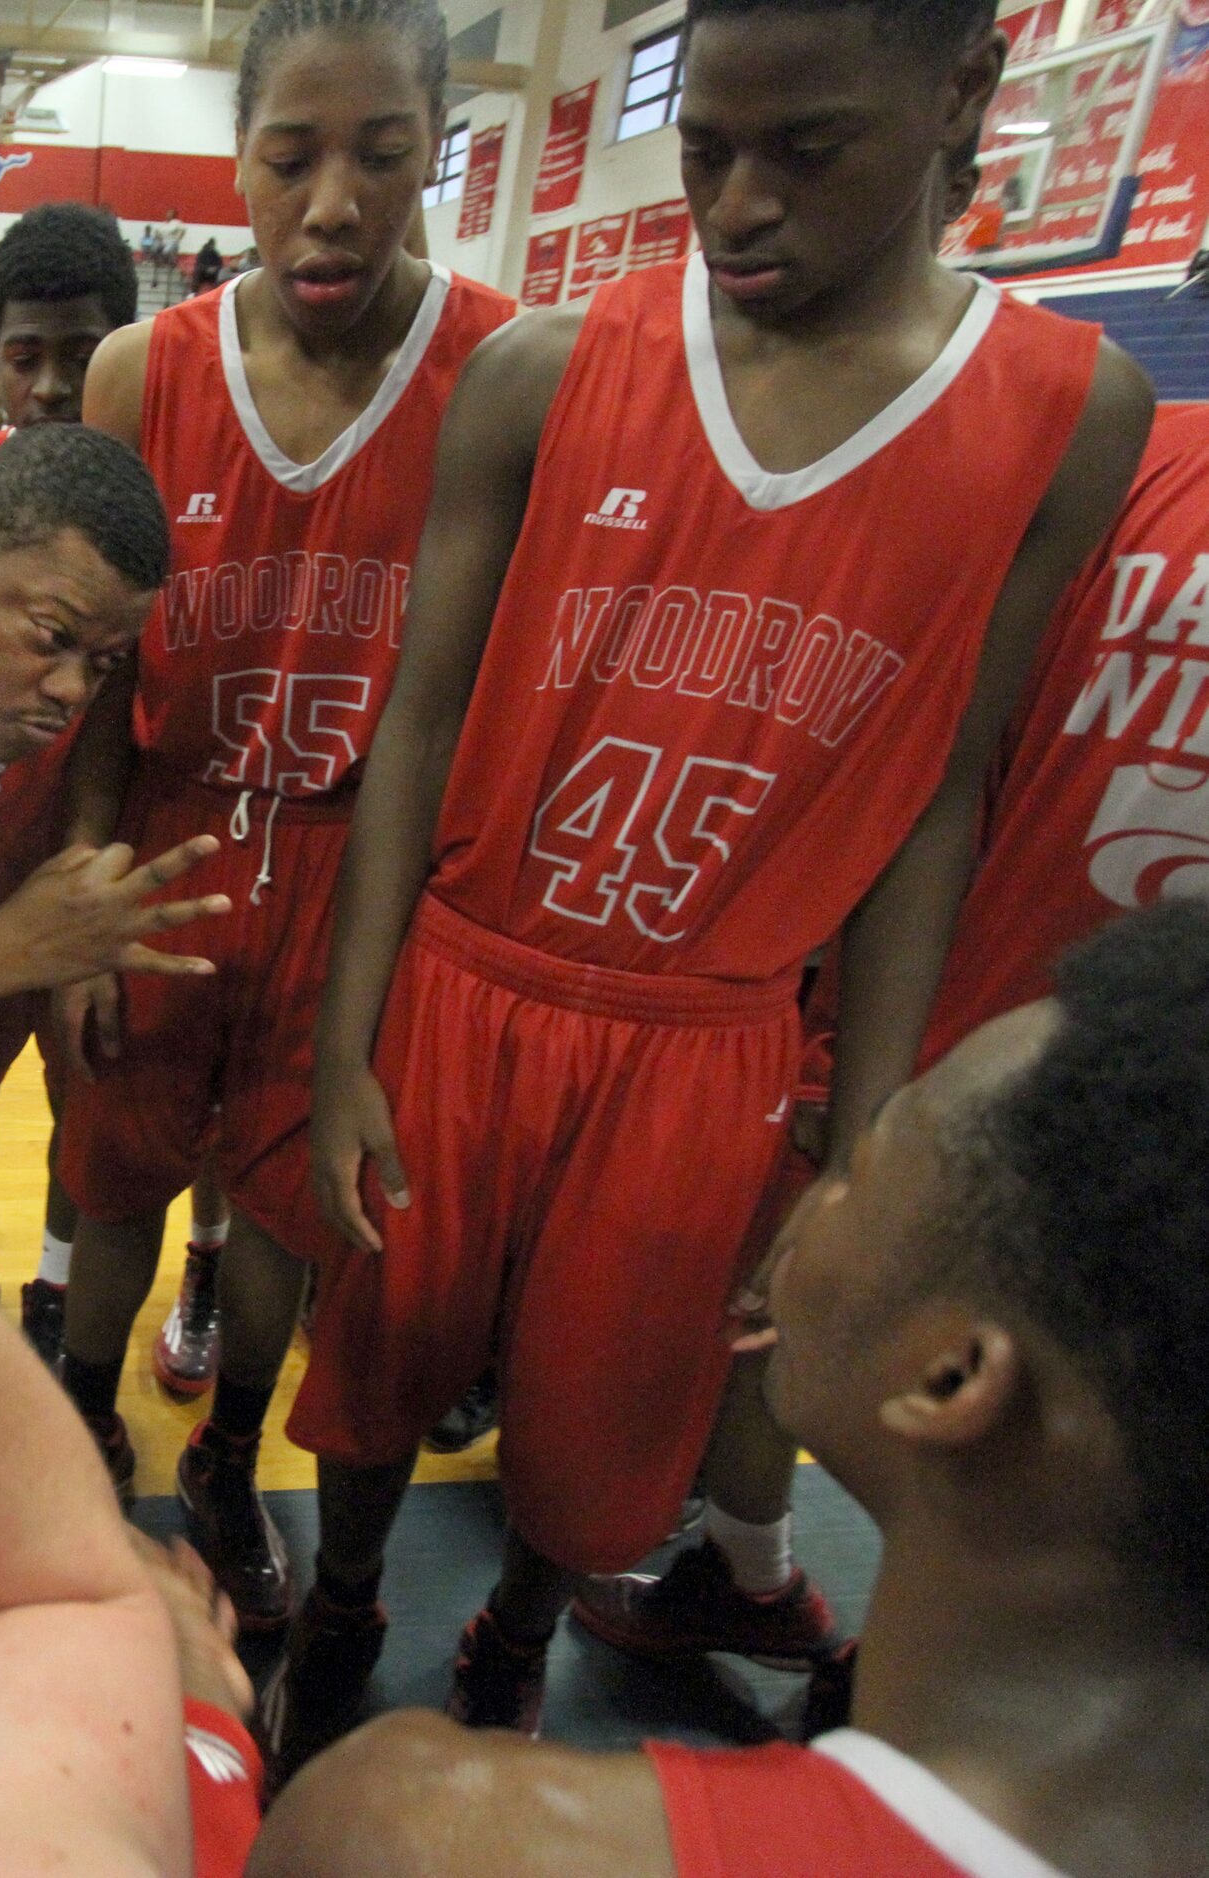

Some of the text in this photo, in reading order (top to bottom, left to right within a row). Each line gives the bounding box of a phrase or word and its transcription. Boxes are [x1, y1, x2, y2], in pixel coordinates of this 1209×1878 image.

[583, 512, 647, 531] RUSSELL
[201, 668, 372, 797] 55
[529, 735, 778, 943] 45
